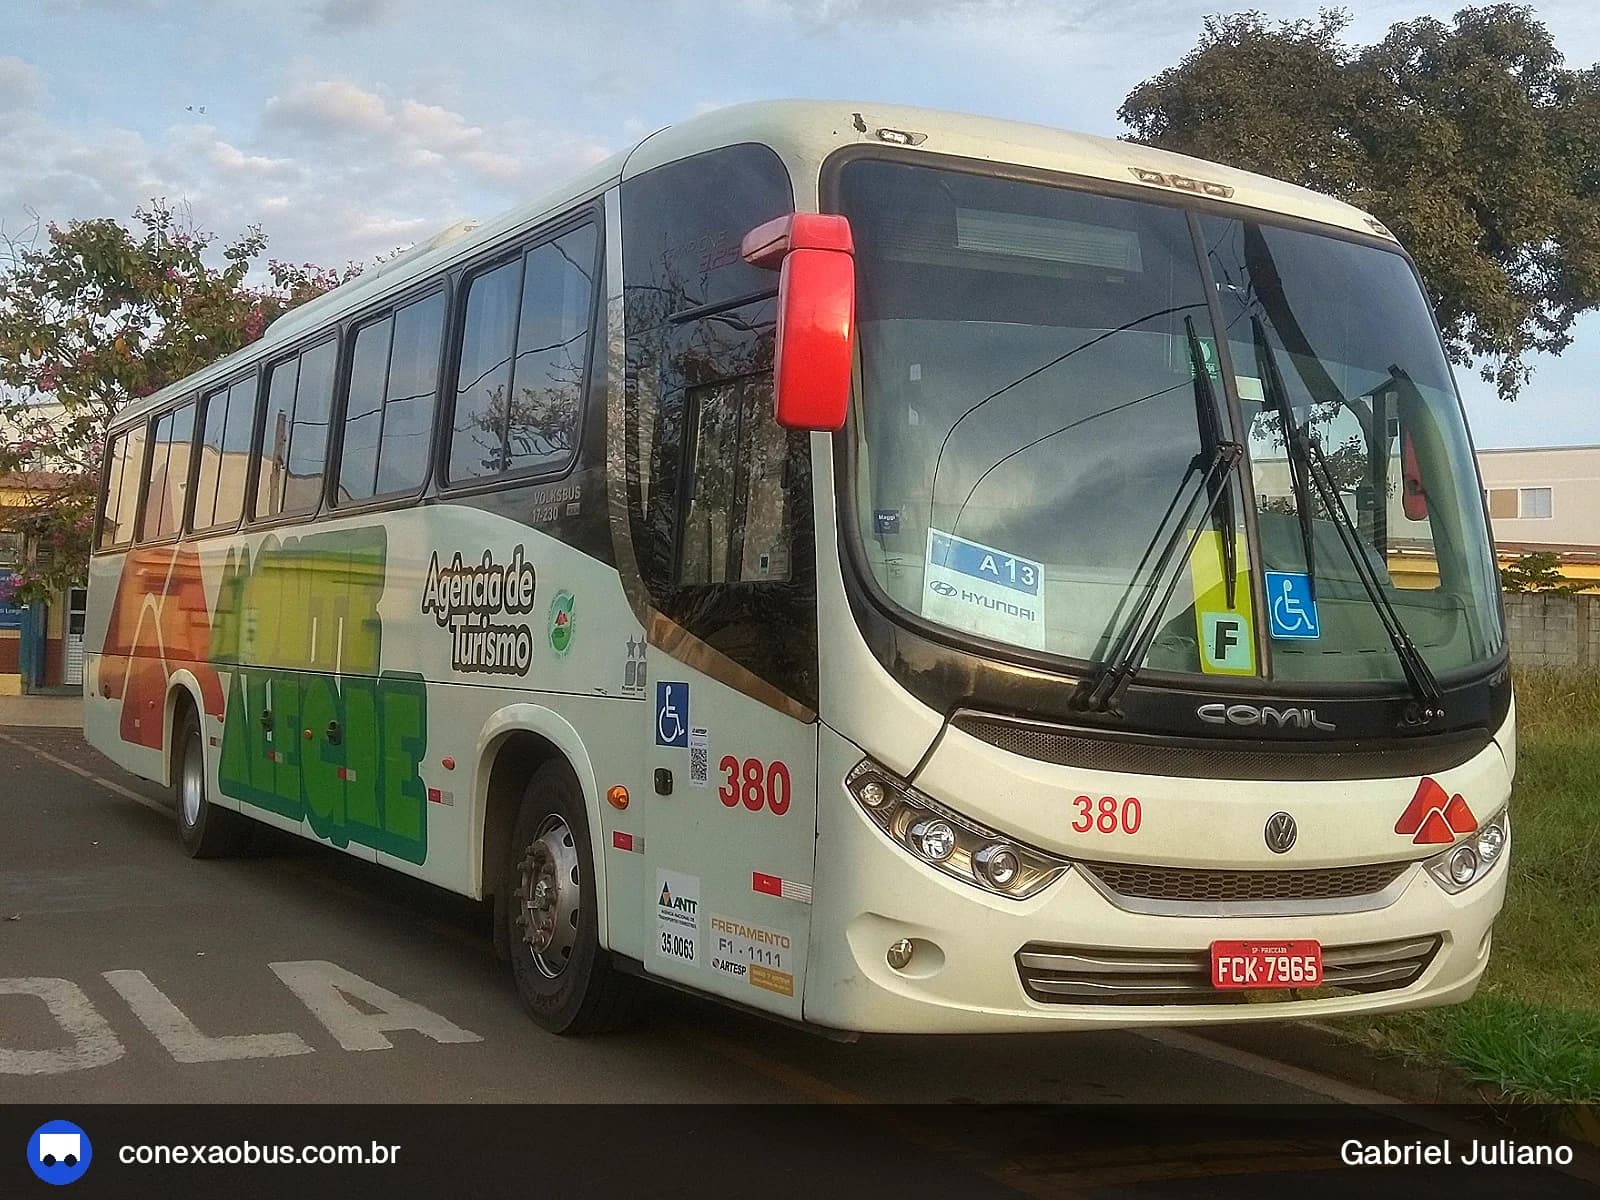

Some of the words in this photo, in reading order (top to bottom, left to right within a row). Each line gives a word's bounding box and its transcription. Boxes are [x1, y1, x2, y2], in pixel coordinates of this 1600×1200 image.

[534, 485, 581, 505] VOLKSBUS
[422, 550, 504, 627] Agência
[504, 544, 536, 615] de
[961, 589, 1035, 622] HYUNDAI
[449, 613, 533, 677] Turismo
[1214, 621, 1239, 660] F
[1196, 703, 1337, 732] COMIL
[718, 755, 791, 816] 380
[1071, 795, 1142, 836] 380
[673, 896, 698, 914] ANTT
[661, 931, 694, 961] 35.0063
[711, 918, 790, 949] FRETAMENTO
[719, 937, 733, 954] F1
[748, 946, 781, 968] 1111
[719, 959, 747, 976] ARTESP
